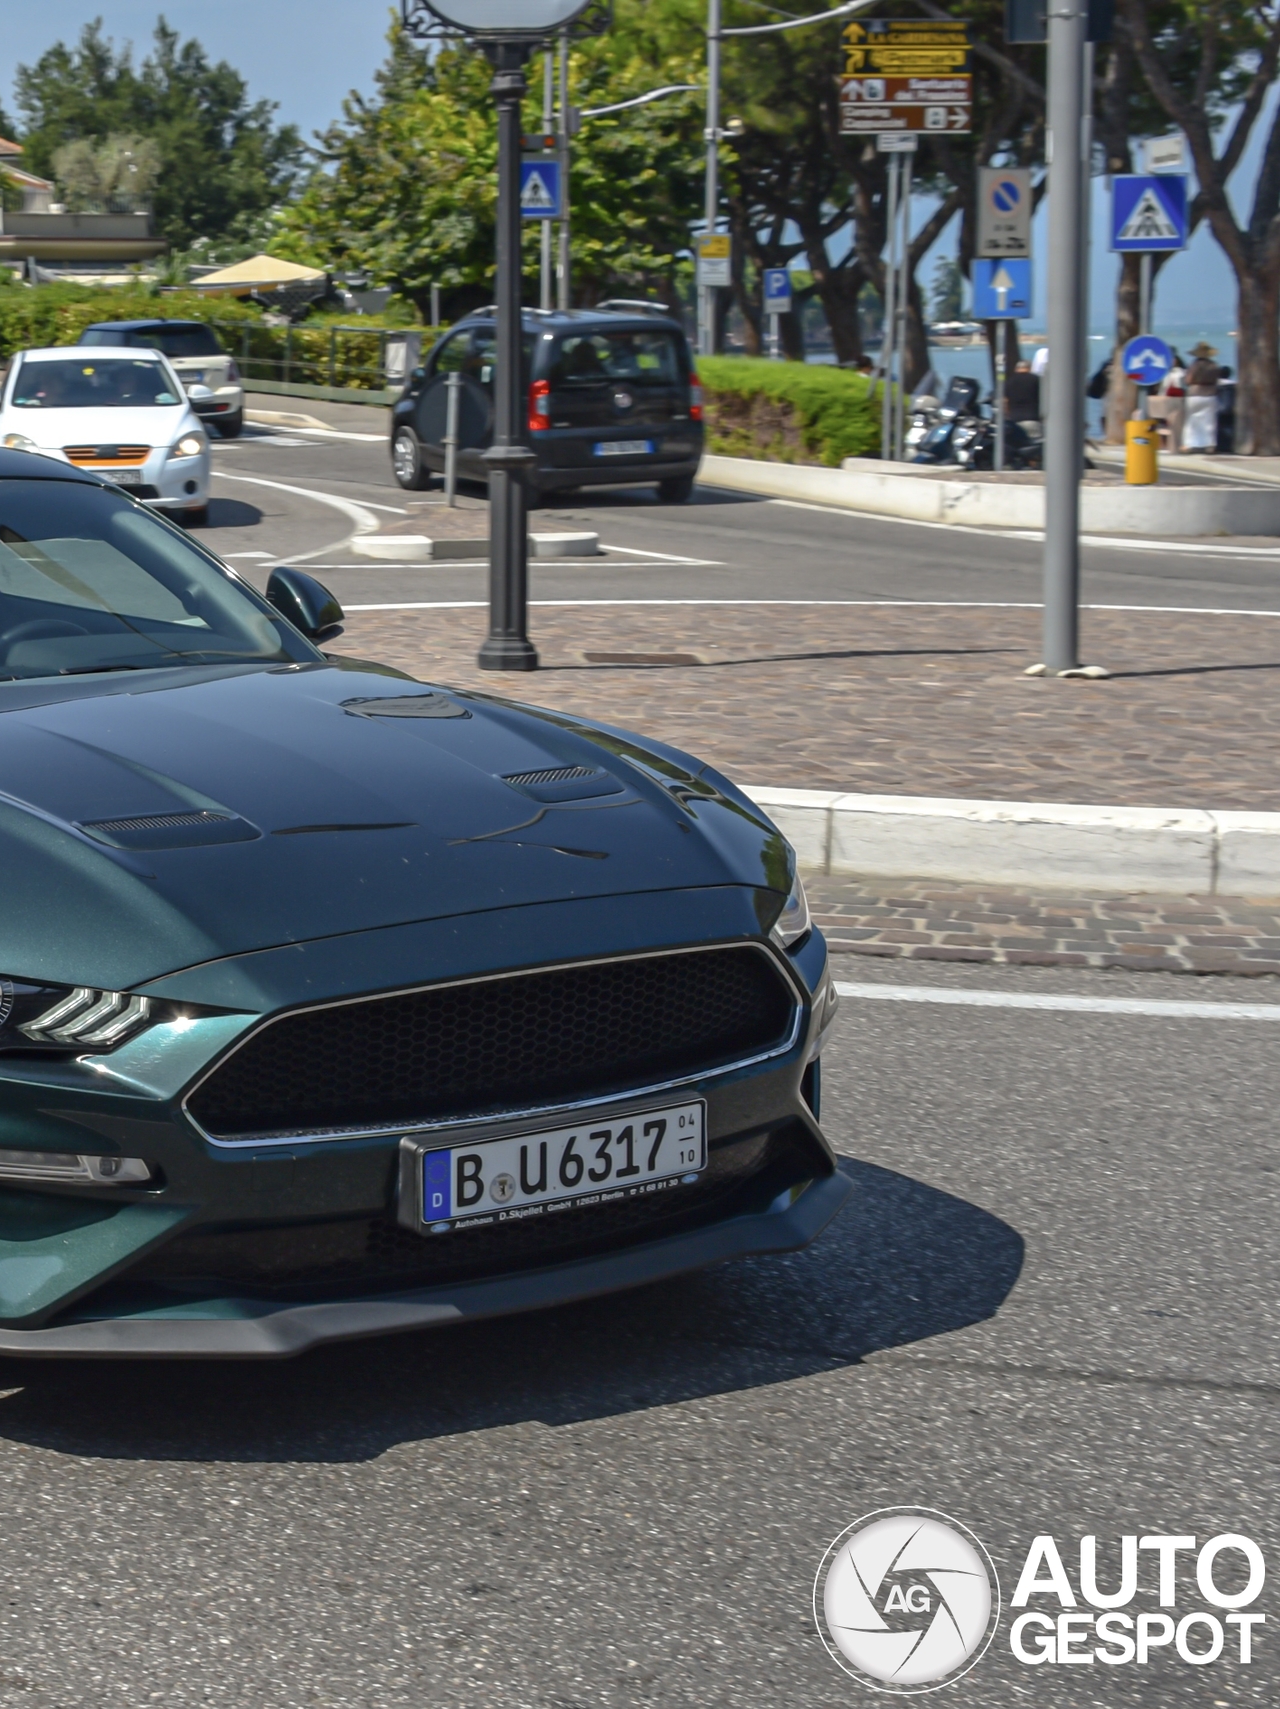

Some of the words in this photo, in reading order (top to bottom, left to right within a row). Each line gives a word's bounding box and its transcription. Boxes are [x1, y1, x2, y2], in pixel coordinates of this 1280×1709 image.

[770, 273, 785, 295] P
[679, 1113, 694, 1128] 04
[680, 1150, 694, 1164] 10
[433, 1193, 443, 1207] D
[457, 1154, 484, 1207] B
[455, 1217, 494, 1229] Autohaus
[547, 1201, 571, 1212] GmbH
[601, 1191, 625, 1201] Berlin
